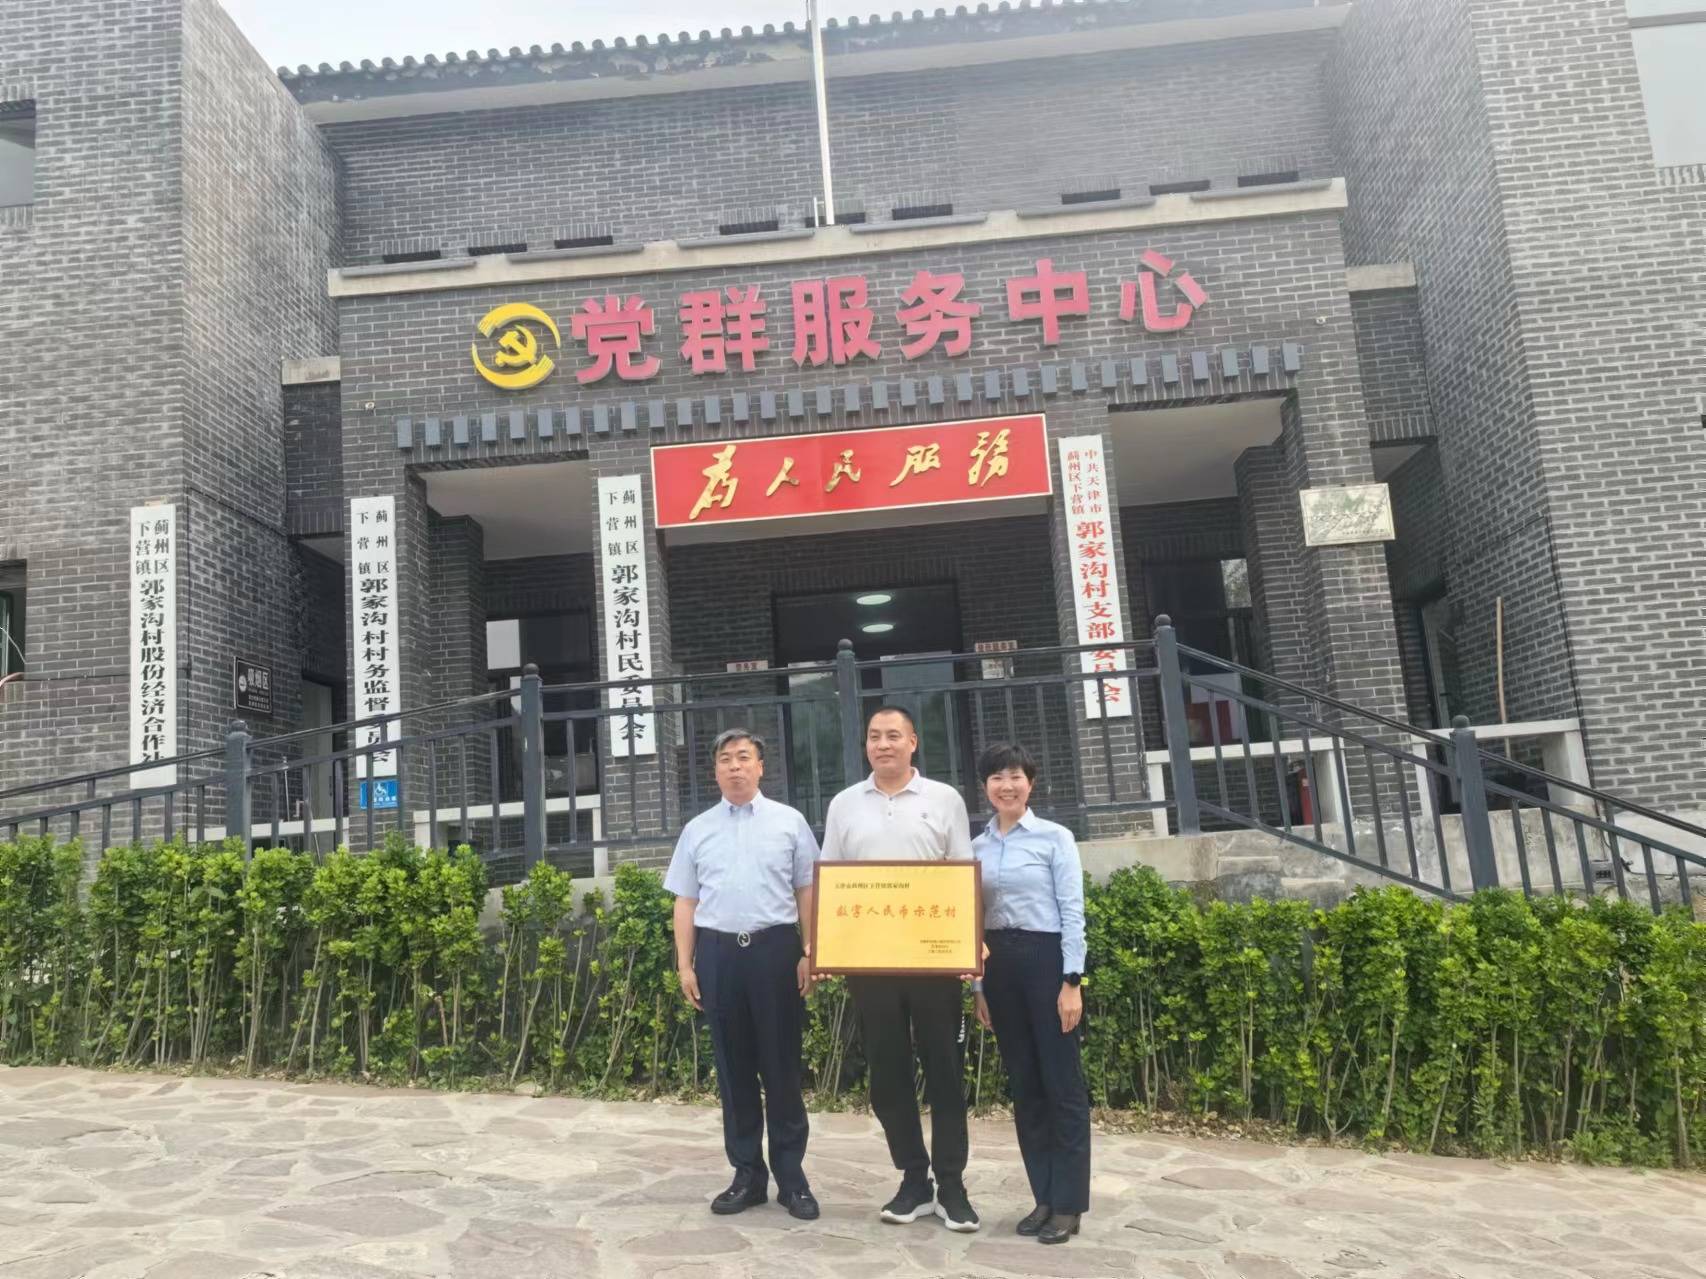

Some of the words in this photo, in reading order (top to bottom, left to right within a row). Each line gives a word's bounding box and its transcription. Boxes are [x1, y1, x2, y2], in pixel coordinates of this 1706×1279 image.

[571, 250, 1208, 385] 党群服务中心
[1067, 450, 1084, 515] 蓟州区下营镇
[1084, 449, 1102, 513] 中共天津市
[135, 520, 151, 575] 下营镇
[154, 519, 169, 574] 蓟州区
[356, 511, 370, 574] 下营镇
[376, 509, 389, 573] 蓟州区
[605, 491, 621, 556] 下营镇
[623, 490, 639, 554] 蓟州区
[360, 579, 391, 763] 郭家沟村村务监督会
[836, 904, 957, 919] 数字人民币示范村
